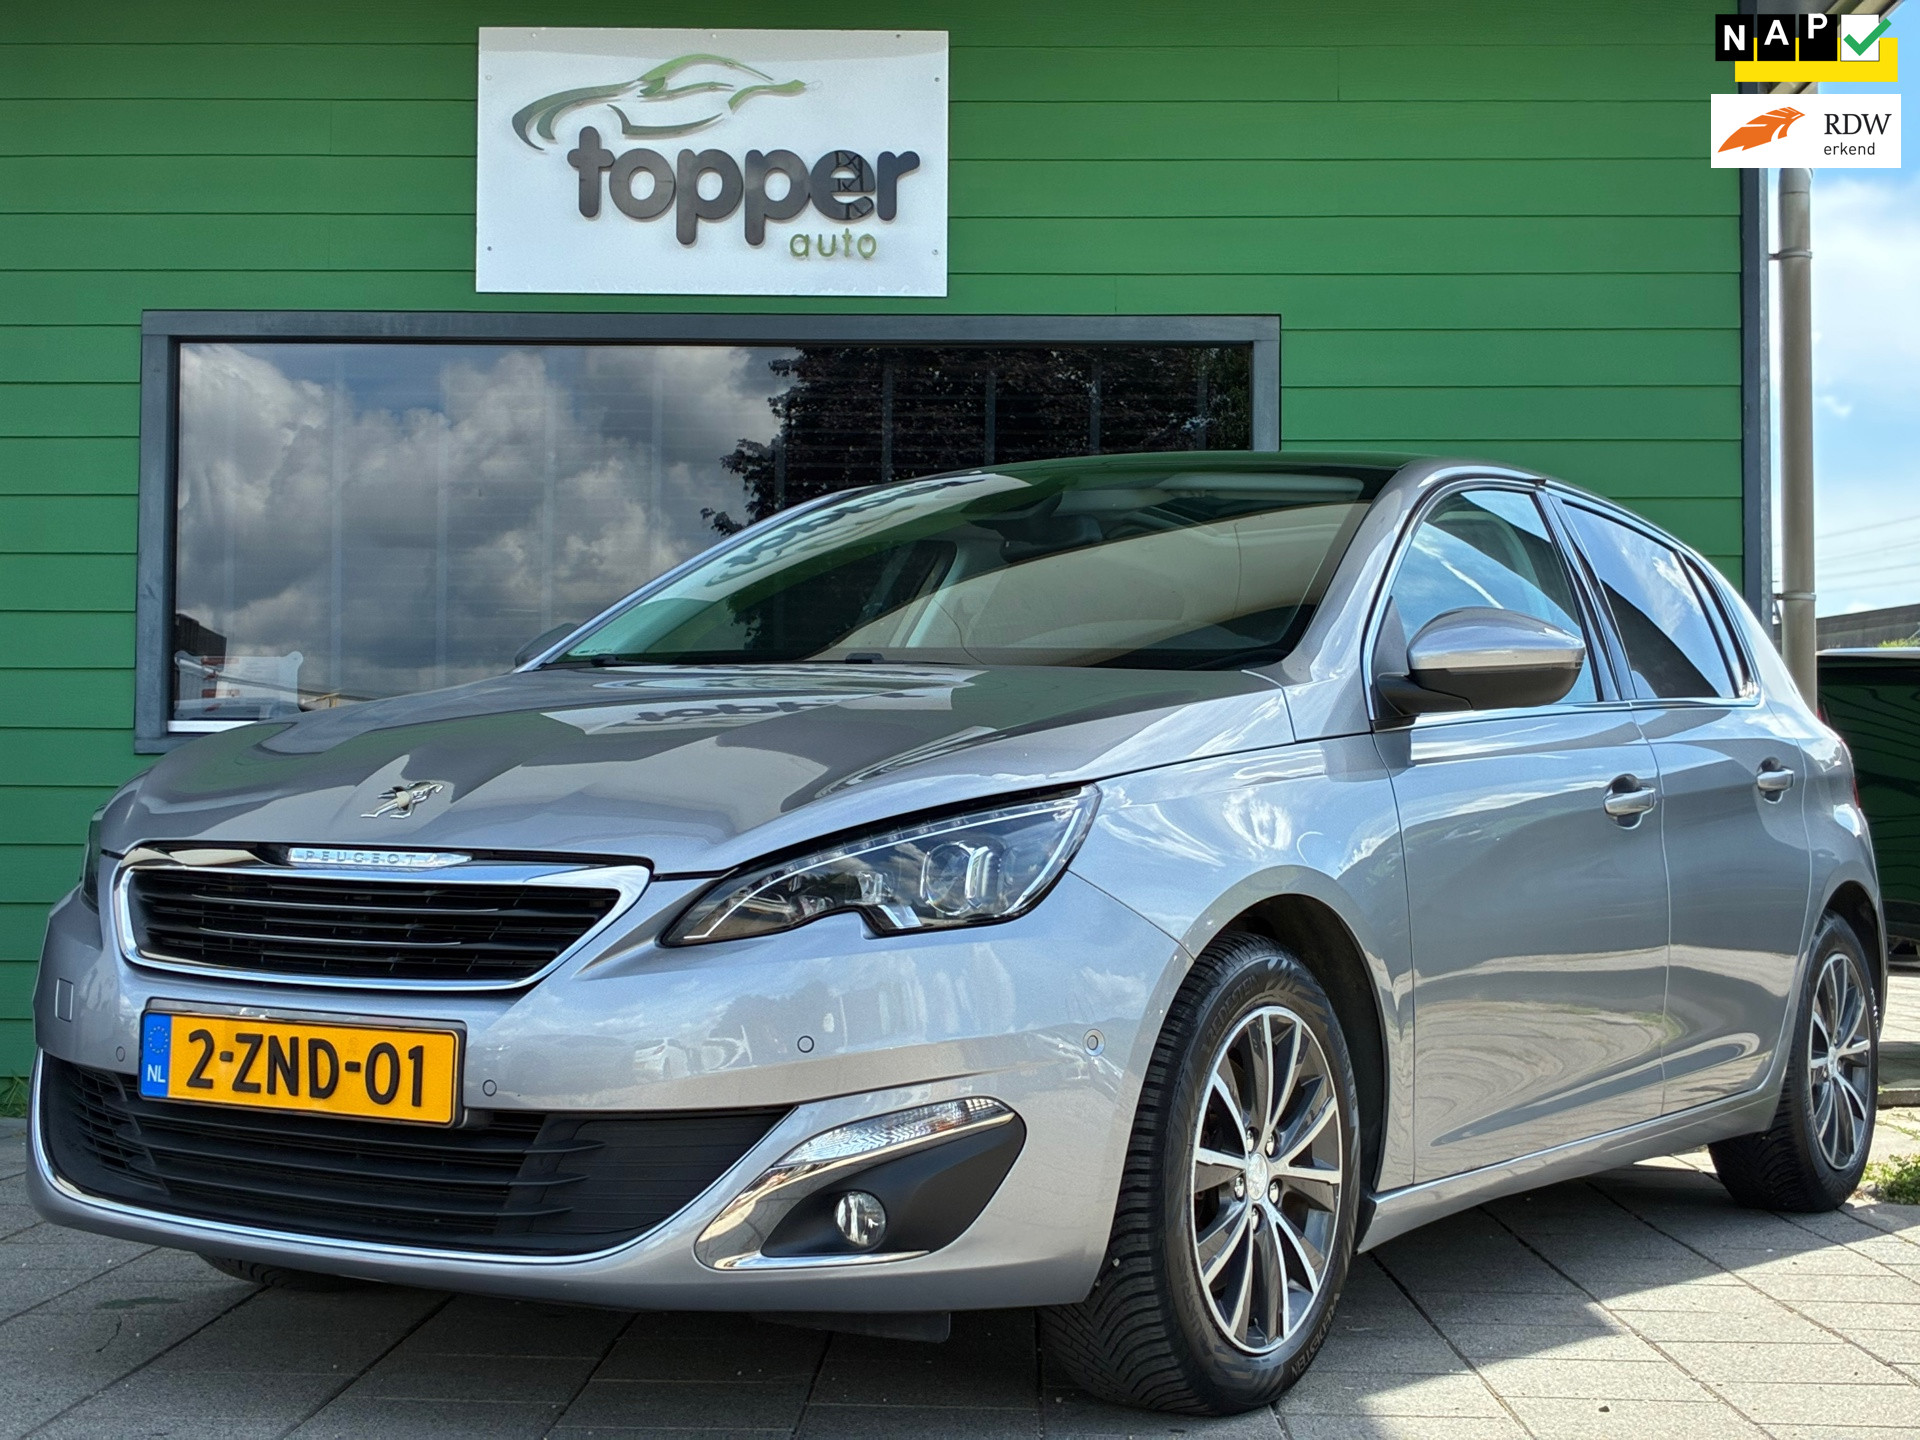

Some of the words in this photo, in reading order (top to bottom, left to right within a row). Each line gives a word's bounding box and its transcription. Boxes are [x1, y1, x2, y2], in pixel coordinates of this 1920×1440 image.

[566, 125, 920, 246] topper
[789, 228, 877, 258] auto
[305, 850, 417, 864] PEUGEOT
[147, 1064, 166, 1083] NL
[186, 1029, 424, 1107] 2-ZND-01
